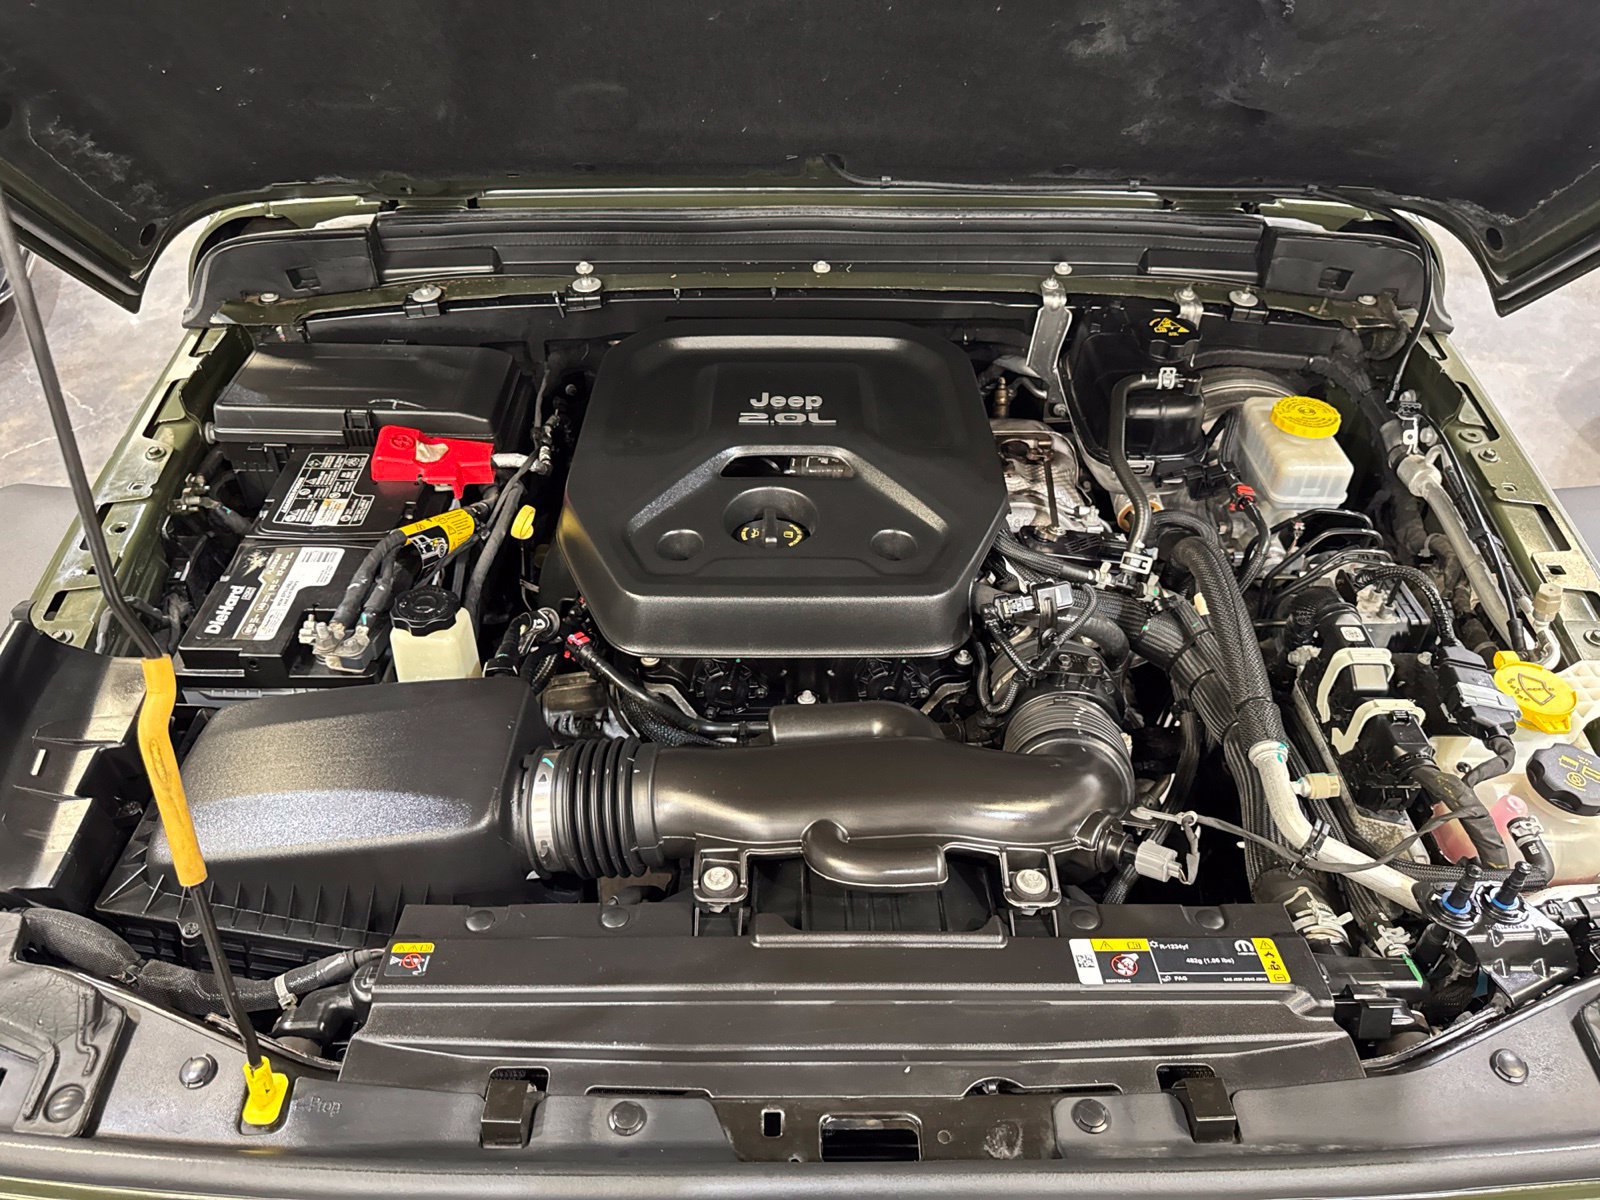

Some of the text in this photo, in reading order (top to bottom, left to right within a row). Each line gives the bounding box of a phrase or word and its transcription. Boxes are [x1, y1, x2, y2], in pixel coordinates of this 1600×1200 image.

[749, 392, 823, 410] Jeep
[738, 412, 837, 425] 2.0L
[204, 585, 246, 635] DieHard
